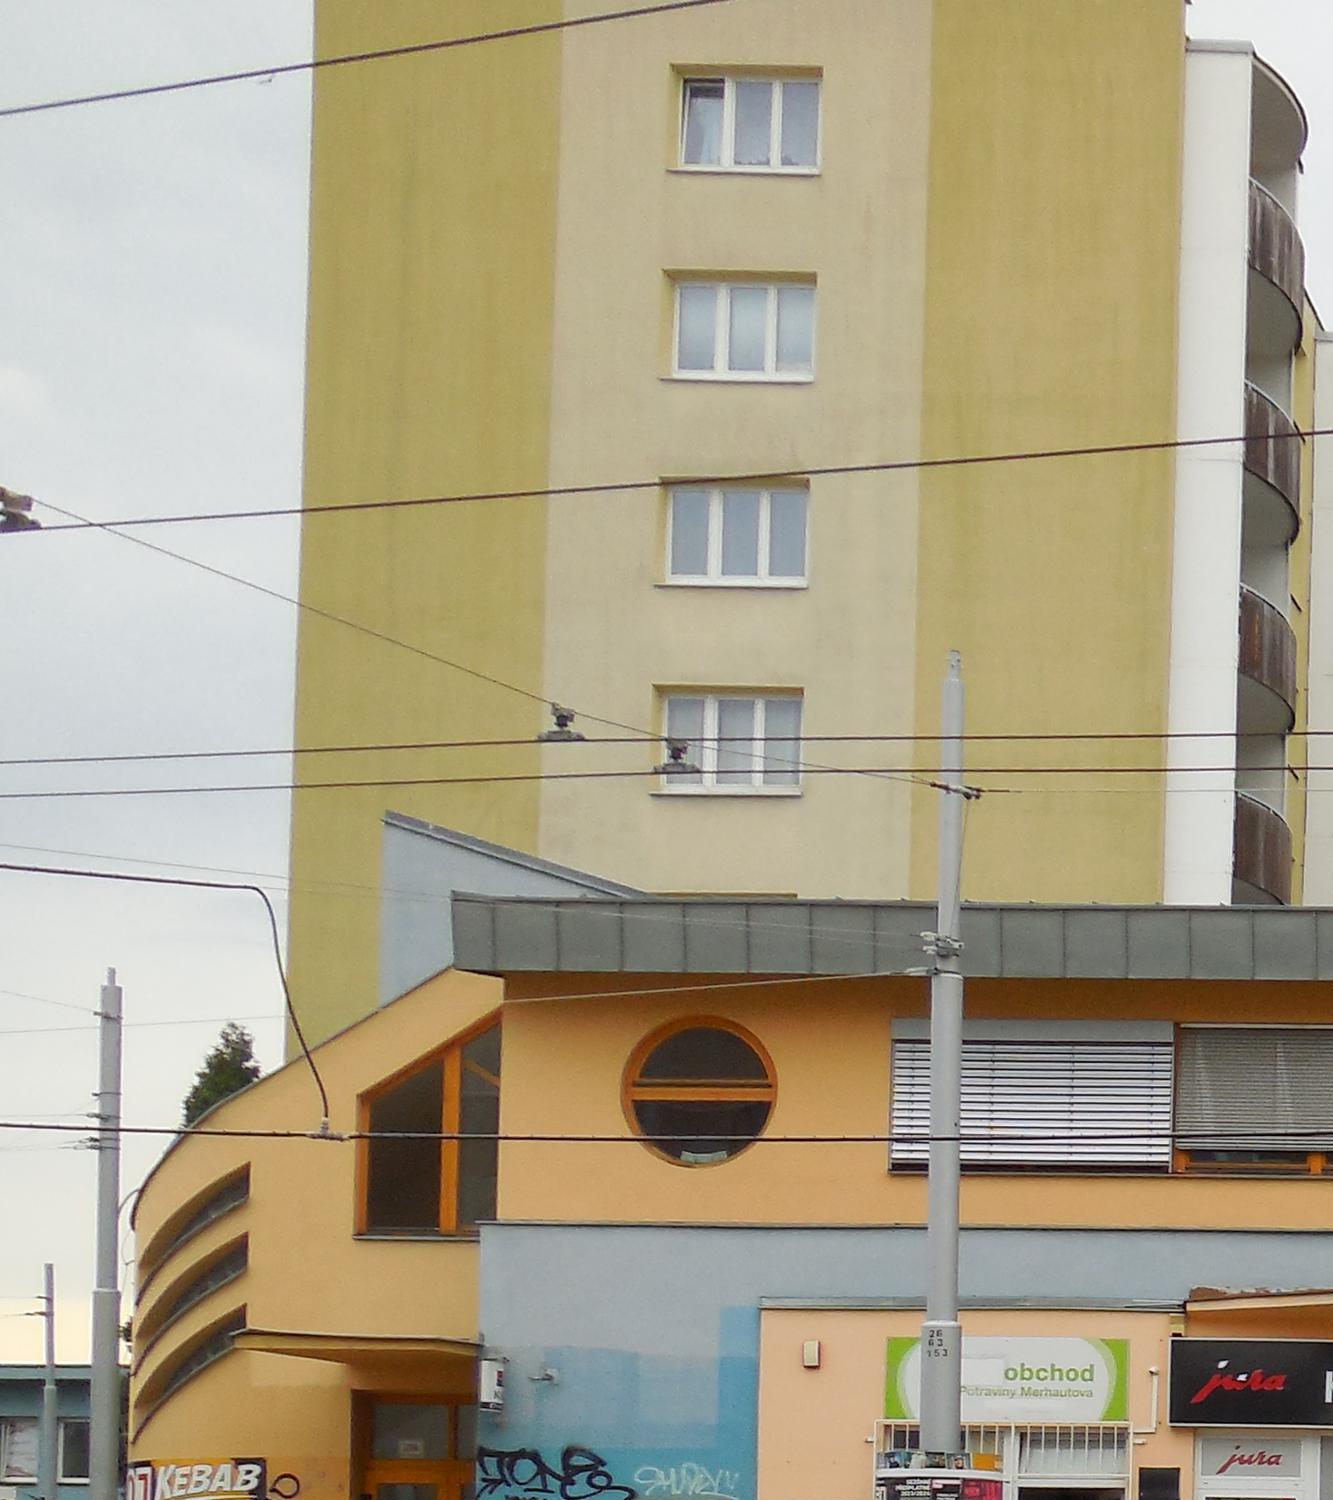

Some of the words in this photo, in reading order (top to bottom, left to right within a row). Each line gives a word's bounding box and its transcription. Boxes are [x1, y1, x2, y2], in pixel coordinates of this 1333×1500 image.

[1004, 1363, 1095, 1382] obchod
[1190, 1360, 1286, 1404] jura
[1020, 1386, 1093, 1398] Merhautova
[1216, 1446, 1284, 1475] jura
